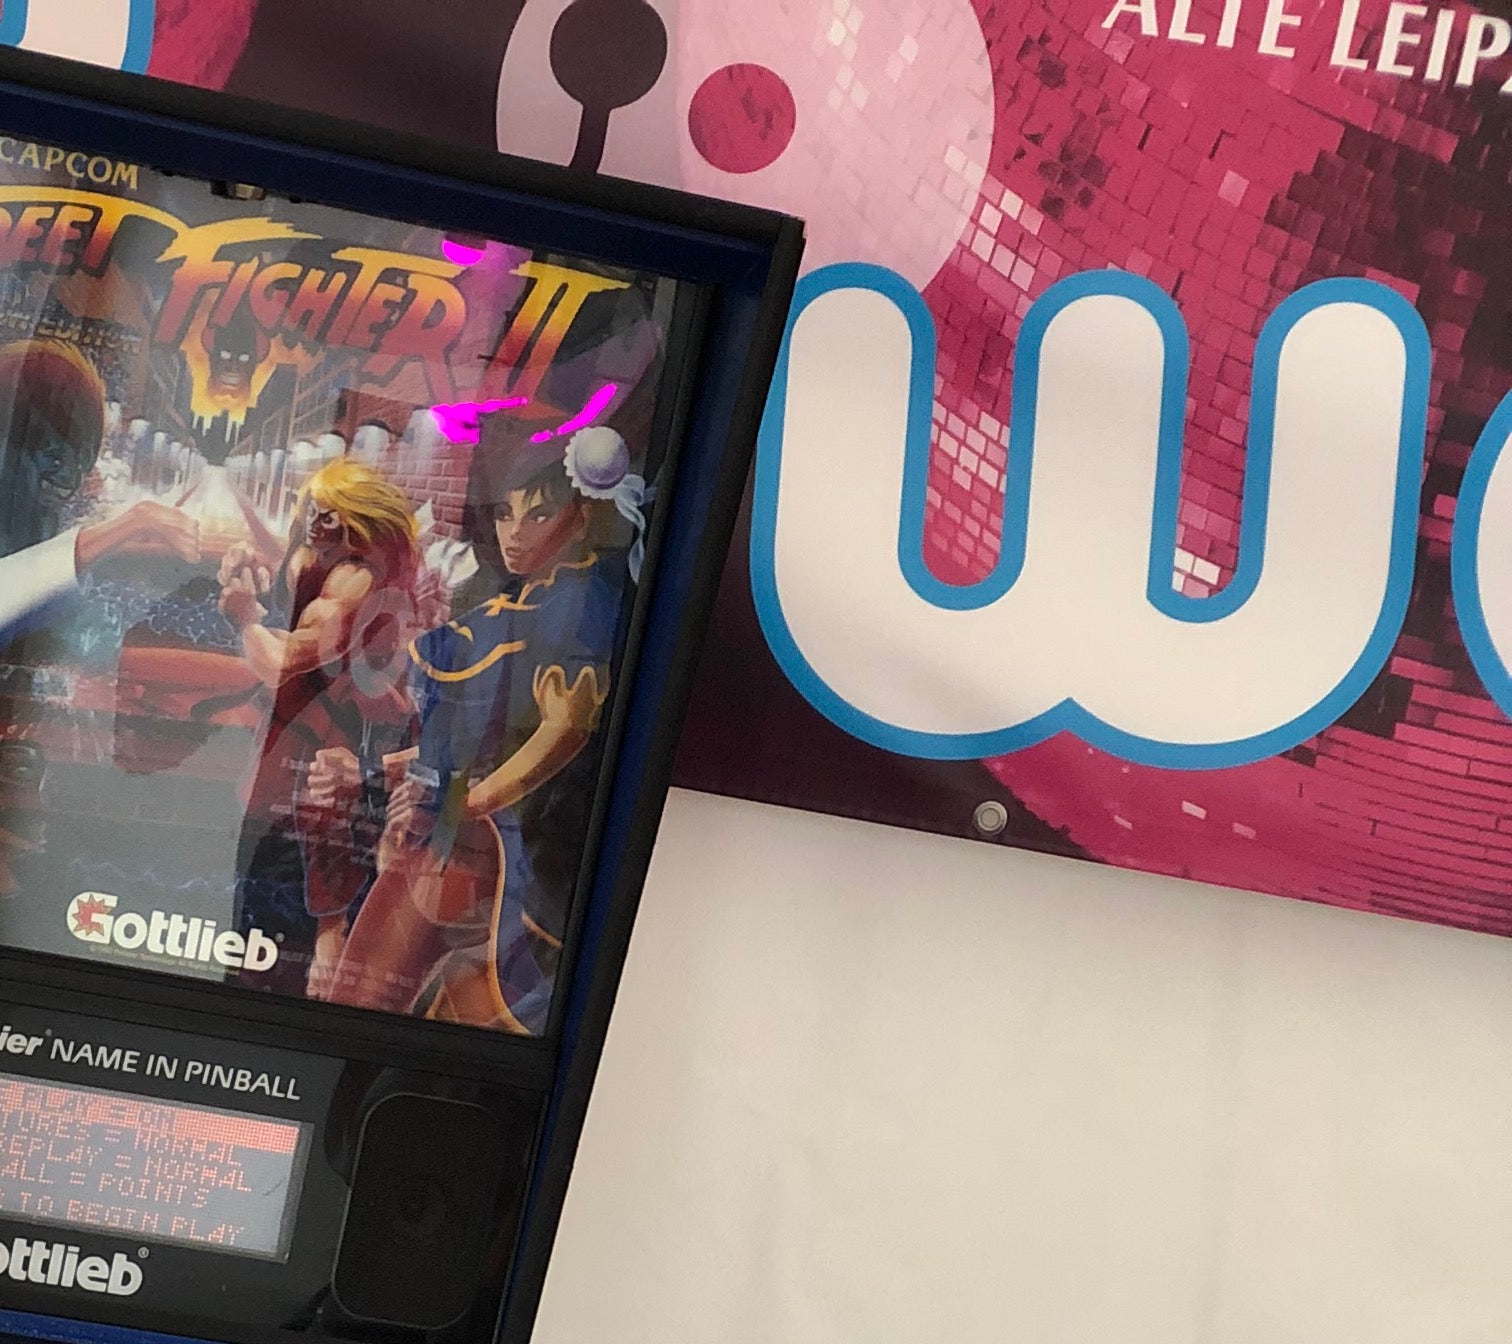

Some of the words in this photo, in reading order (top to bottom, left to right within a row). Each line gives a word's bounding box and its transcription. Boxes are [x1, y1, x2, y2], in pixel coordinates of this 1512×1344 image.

[1329, 0, 1512, 95] LEIP
[155, 216, 473, 402] FIGHTER
[66, 891, 278, 972] Gottlieb
[50, 1036, 141, 1075] NAME
[146, 1053, 180, 1082] IN
[184, 1059, 302, 1102] PINBALL
[132, 1130, 245, 1166] NORMAL
[144, 1155, 255, 1193] NORMAL
[17, 1191, 55, 1217] TO
[65, 1199, 160, 1233] BEGIN
[170, 1215, 245, 1246] PLAY
[97, 1172, 210, 1209] POINTS
